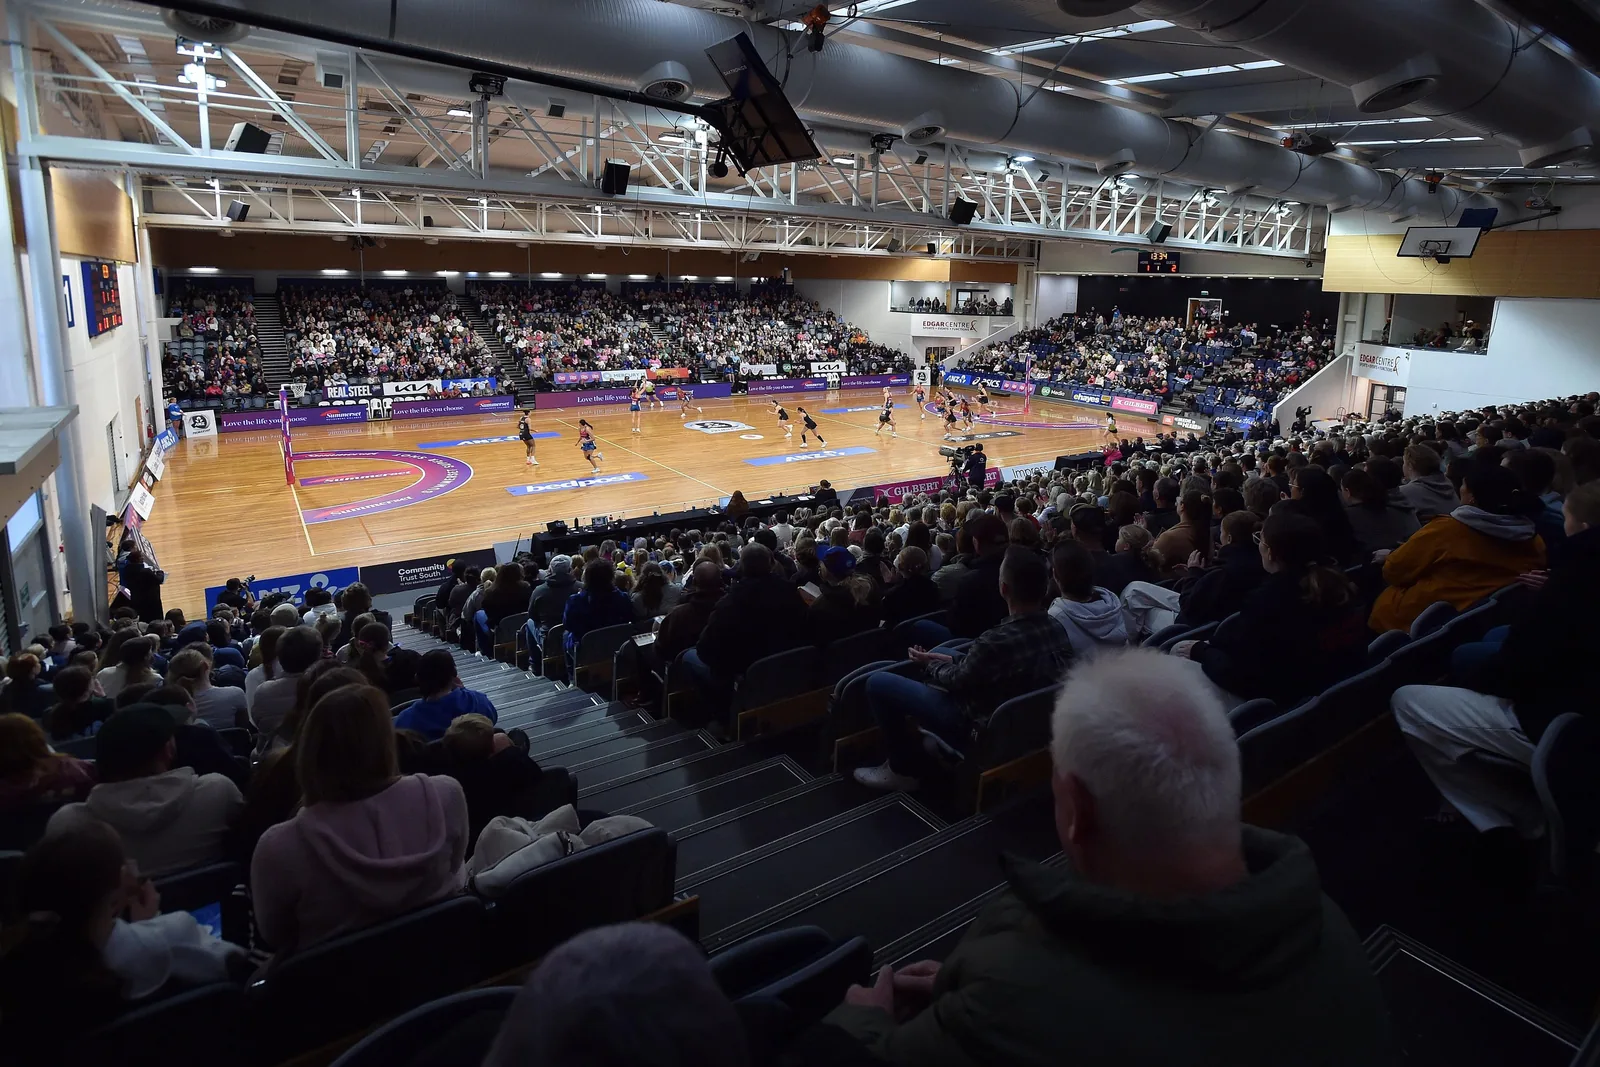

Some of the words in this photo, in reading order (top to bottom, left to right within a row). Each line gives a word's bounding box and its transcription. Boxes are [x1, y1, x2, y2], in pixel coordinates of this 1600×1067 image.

[327, 387, 348, 398] REAL
[348, 385, 372, 397] STEEL
[1074, 393, 1099, 403] ehayes
[1124, 400, 1154, 410] GILBERT
[326, 411, 361, 419] Summerset
[243, 418, 255, 426] the
[256, 417, 267, 425] life
[268, 418, 282, 426] you
[324, 471, 411, 483] Summerset
[526, 473, 634, 493] bedpost
[894, 481, 940, 496] GILBERT
[330, 496, 414, 516] Summerset
[398, 563, 445, 575] Community
[399, 574, 417, 582] Trust
[419, 571, 440, 579] South
